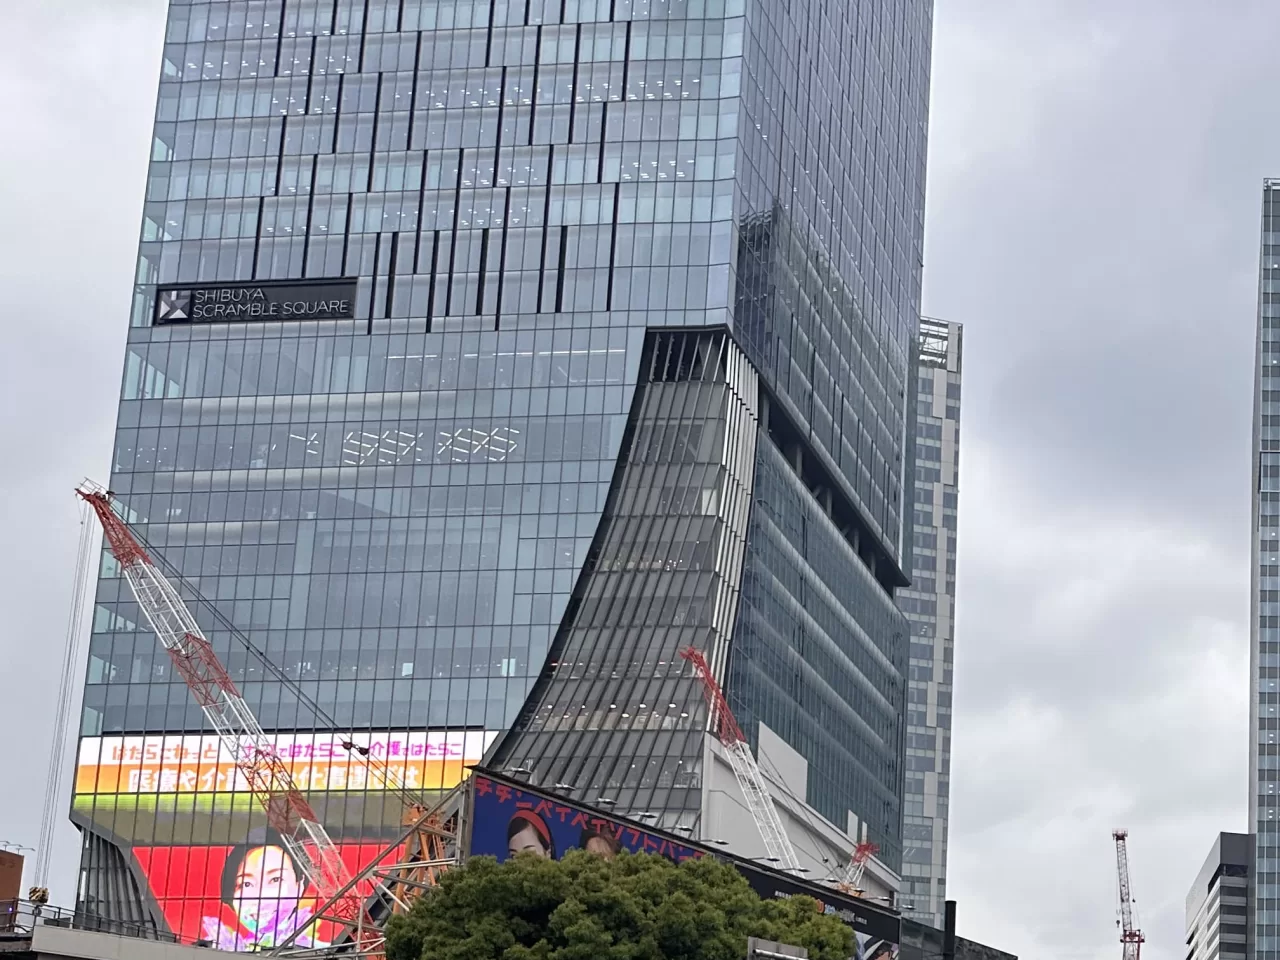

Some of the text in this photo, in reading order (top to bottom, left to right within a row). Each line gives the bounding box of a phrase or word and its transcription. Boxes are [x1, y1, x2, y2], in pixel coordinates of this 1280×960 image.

[194, 288, 265, 303] SHIBUYA
[192, 300, 349, 318] SCRAMBLE SQUARE
